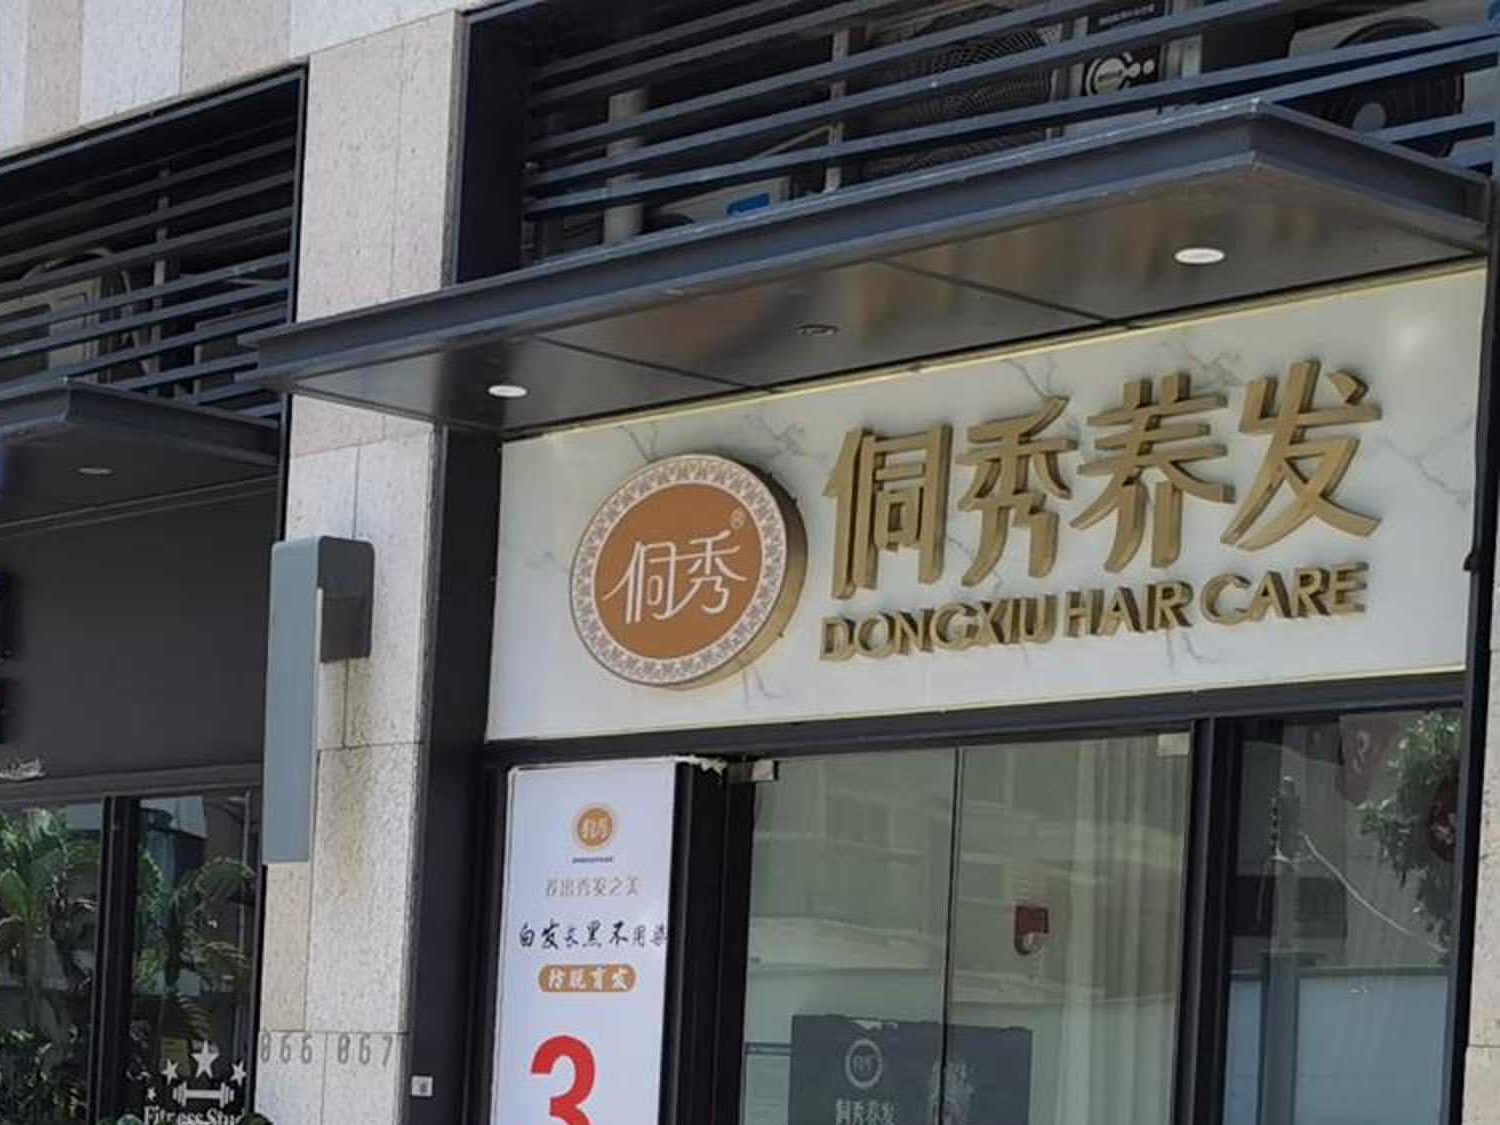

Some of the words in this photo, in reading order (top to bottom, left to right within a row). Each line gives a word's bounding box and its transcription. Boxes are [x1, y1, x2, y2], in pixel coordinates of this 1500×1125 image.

[823, 357, 1383, 598] 侗秀养发
[602, 530, 747, 624] 侗秀
[821, 595, 1057, 661] DONGXIU
[1065, 580, 1192, 638] HAIR
[1199, 561, 1367, 624] CARE
